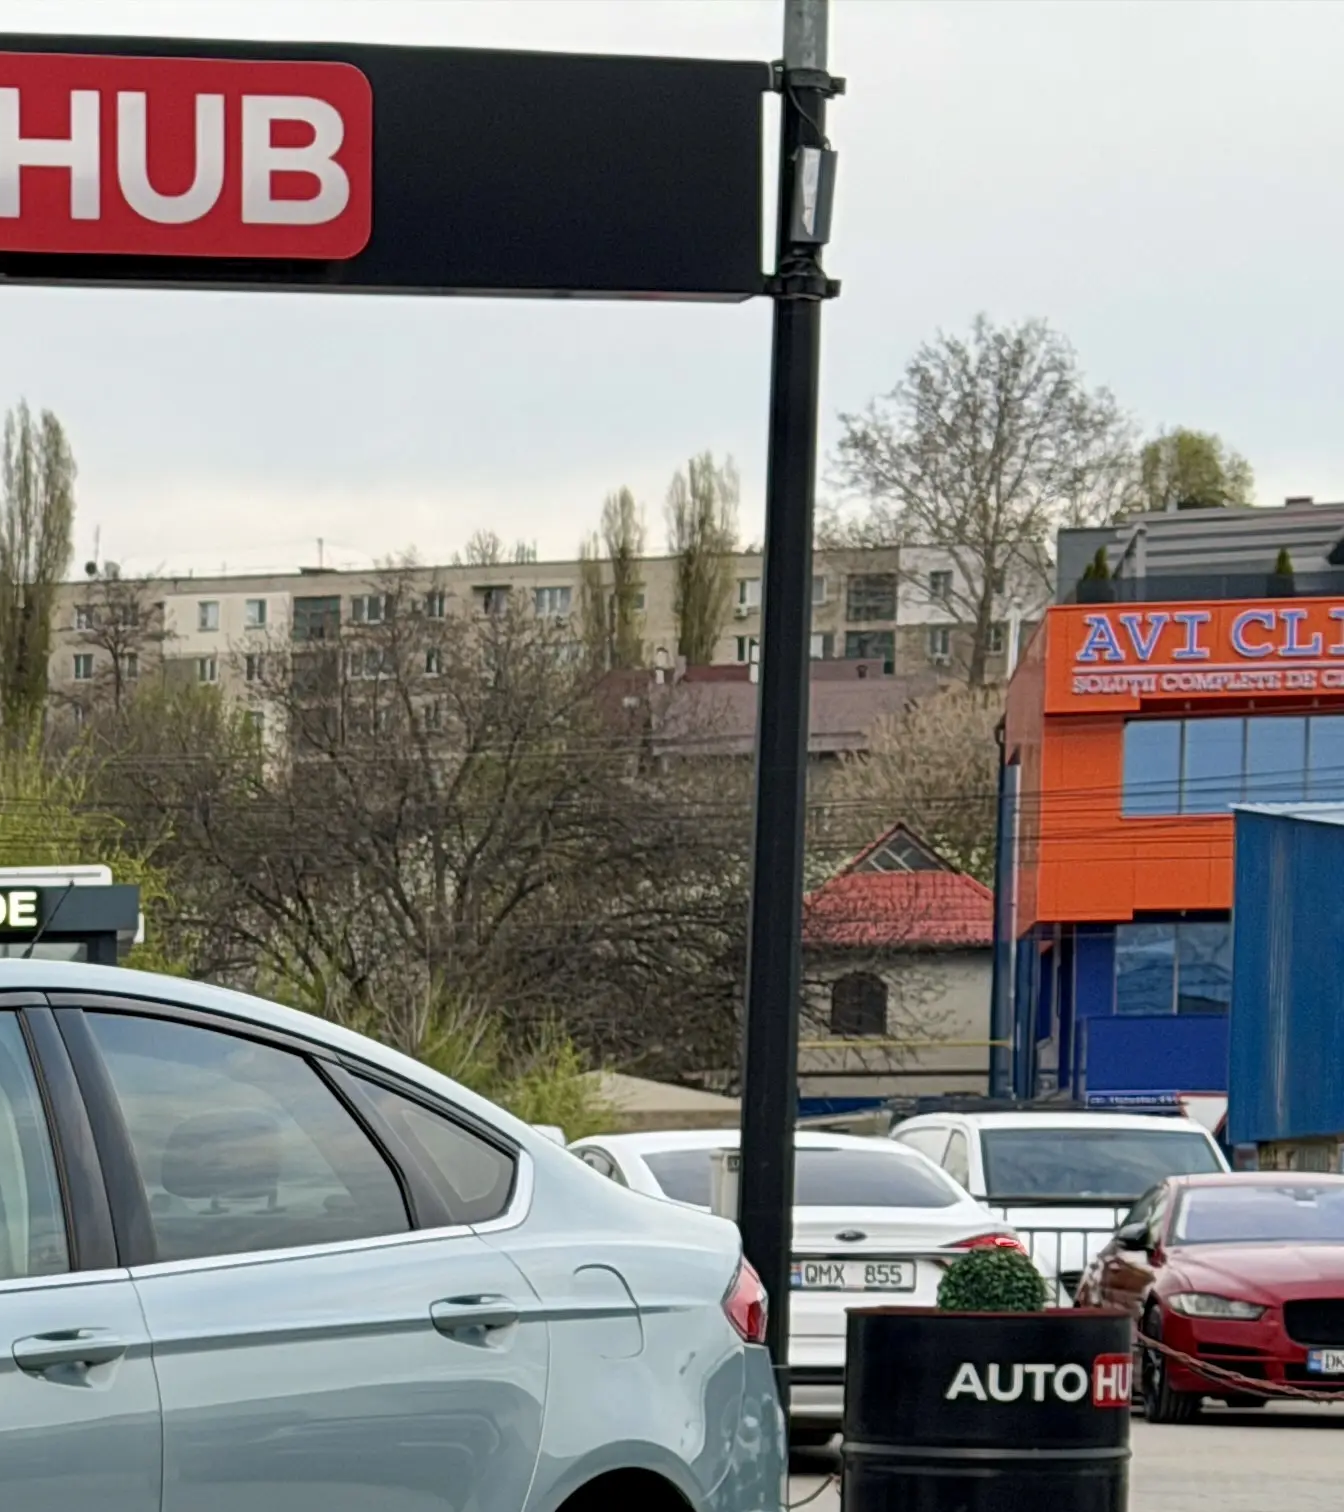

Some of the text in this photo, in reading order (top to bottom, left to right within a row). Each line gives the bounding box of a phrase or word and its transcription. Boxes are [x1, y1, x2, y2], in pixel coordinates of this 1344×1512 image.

[1076, 610, 1211, 662] AVI
[1162, 671, 1281, 692] COMPLETE
[1286, 670, 1317, 691] DE
[804, 1263, 903, 1286] QMX 855
[945, 1362, 1133, 1402] AUTO HU
